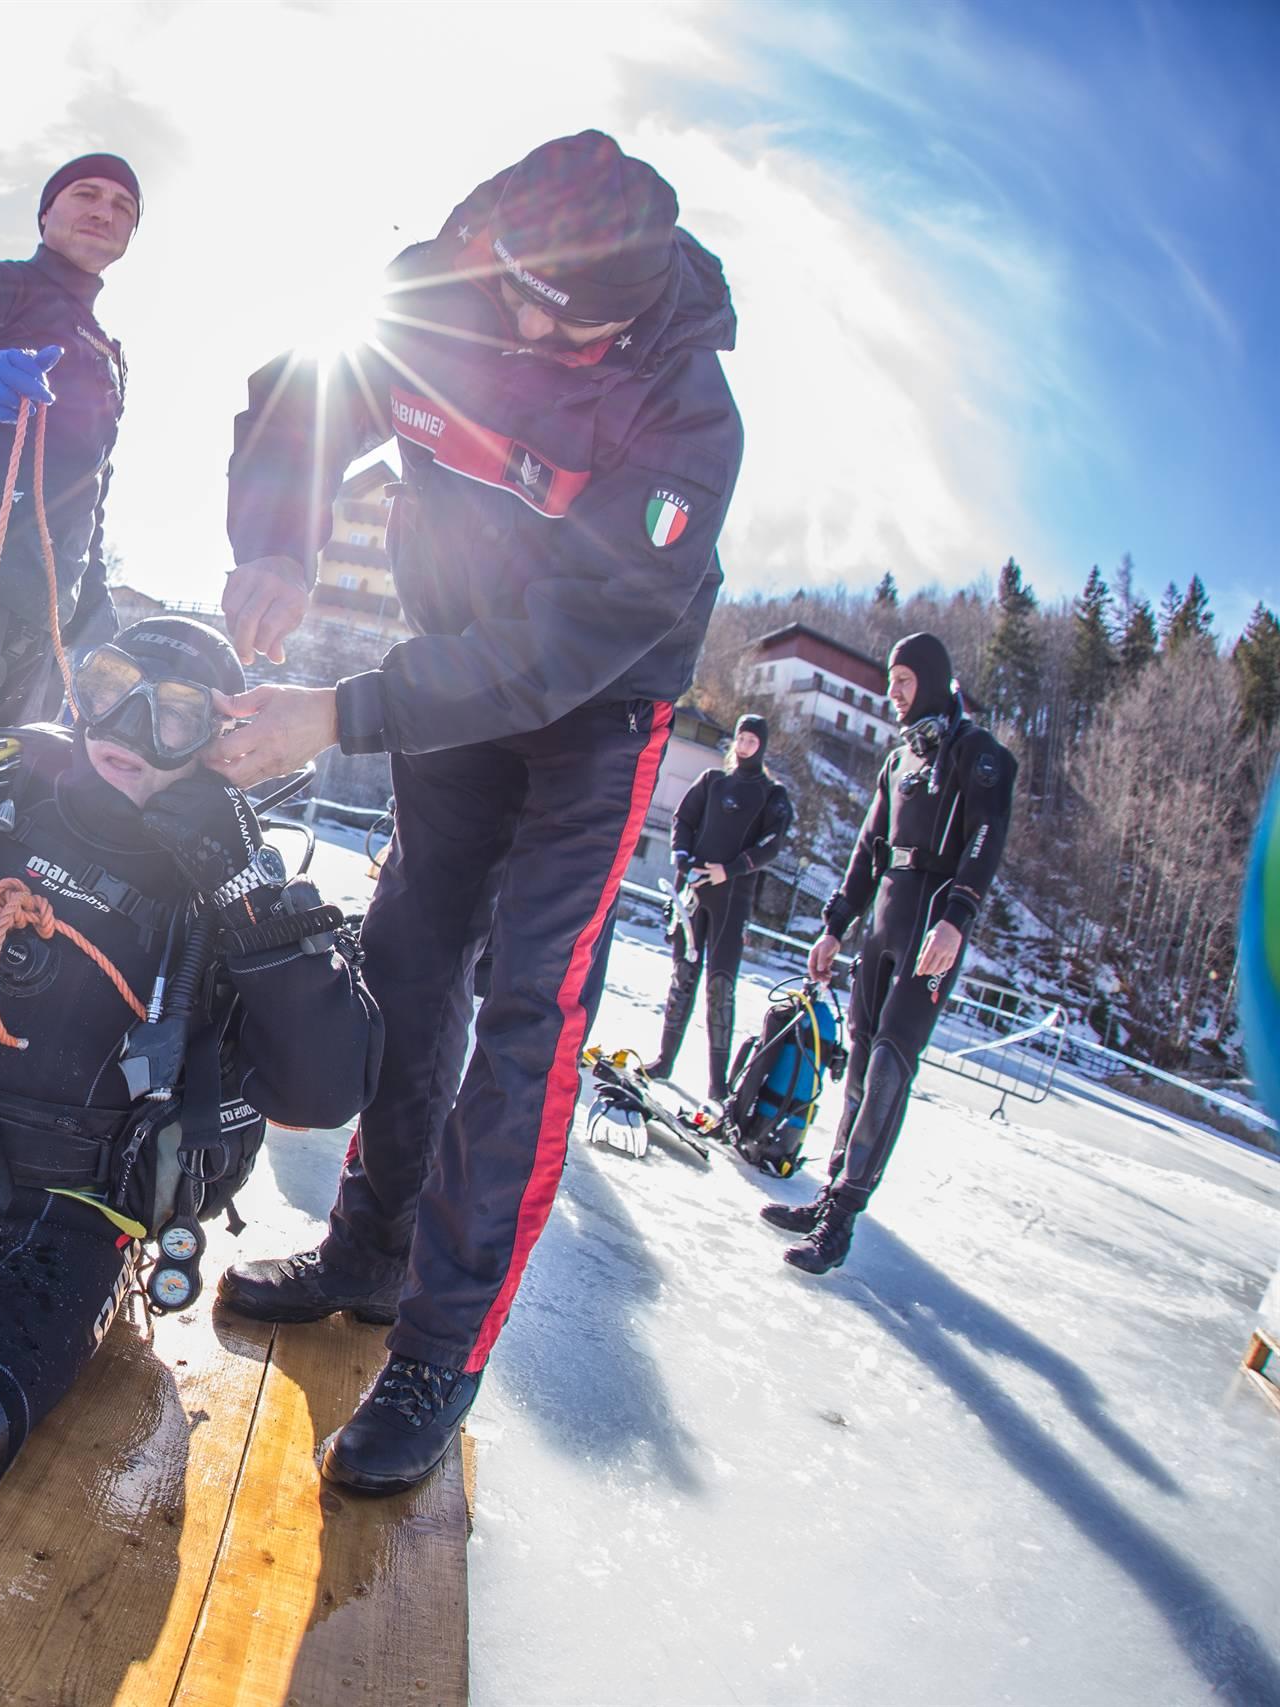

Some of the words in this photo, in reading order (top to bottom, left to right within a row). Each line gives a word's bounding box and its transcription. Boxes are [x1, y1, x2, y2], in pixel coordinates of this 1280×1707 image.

[656, 490, 689, 513] ITALIA
[41, 878, 60, 891] by
[59, 888, 112, 913] mobbys
[233, 1103, 257, 1119] 200
